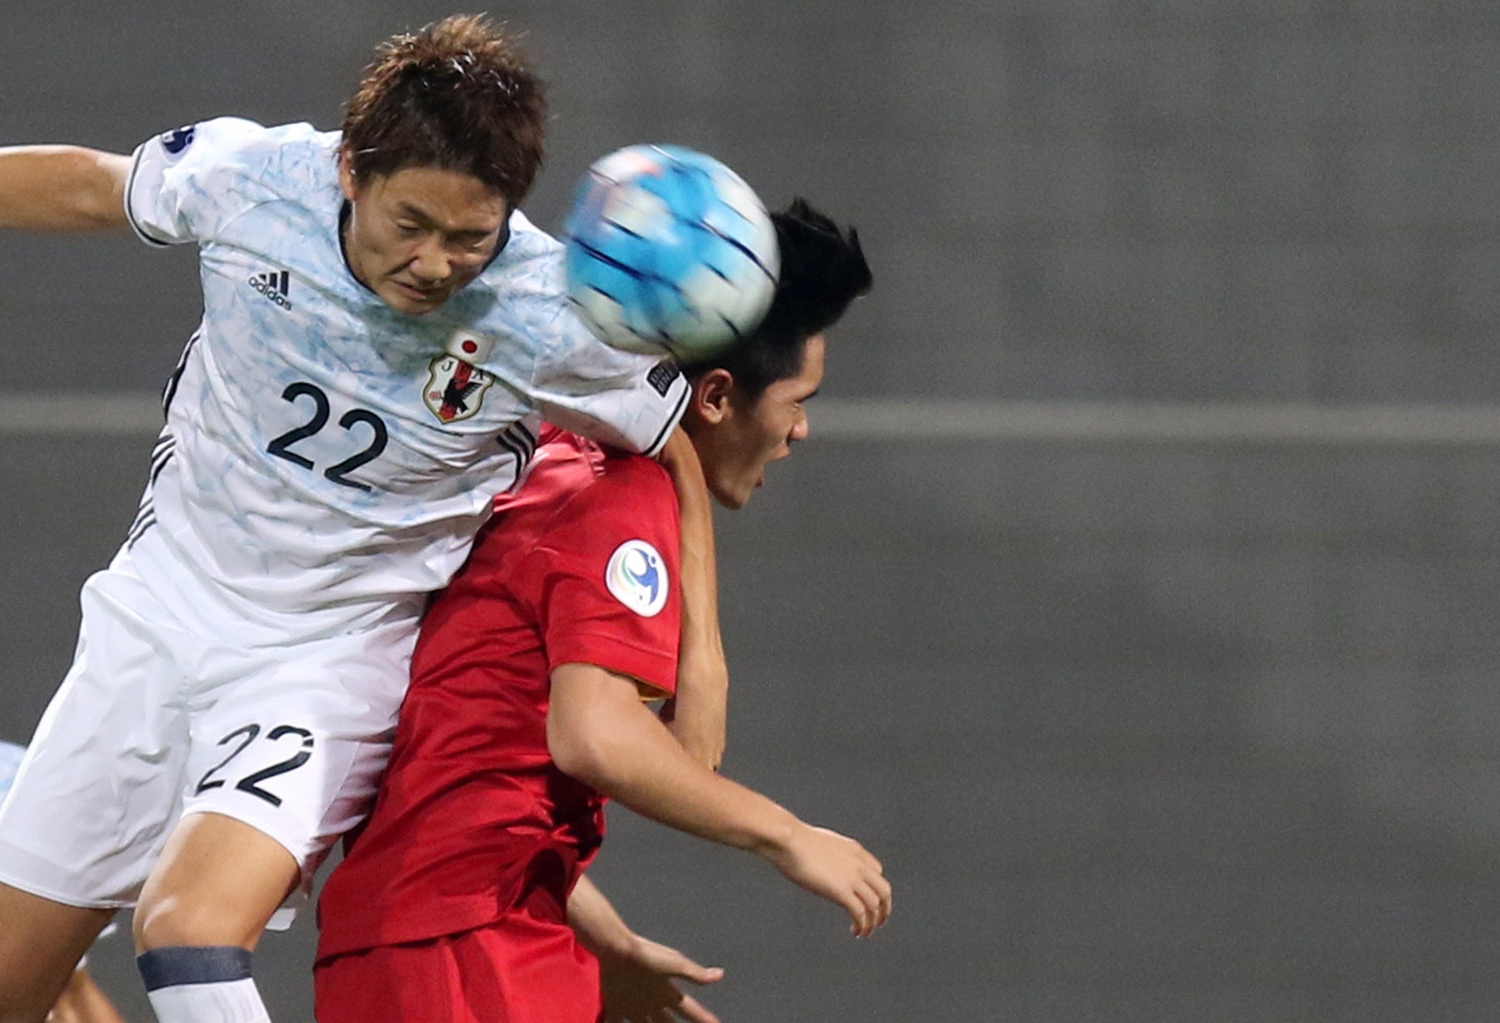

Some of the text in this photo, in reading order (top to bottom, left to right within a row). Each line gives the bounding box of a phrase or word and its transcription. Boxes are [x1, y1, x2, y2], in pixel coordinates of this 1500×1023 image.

[248, 276, 292, 311] adidas
[266, 382, 388, 493] 22
[194, 723, 314, 808] 22
